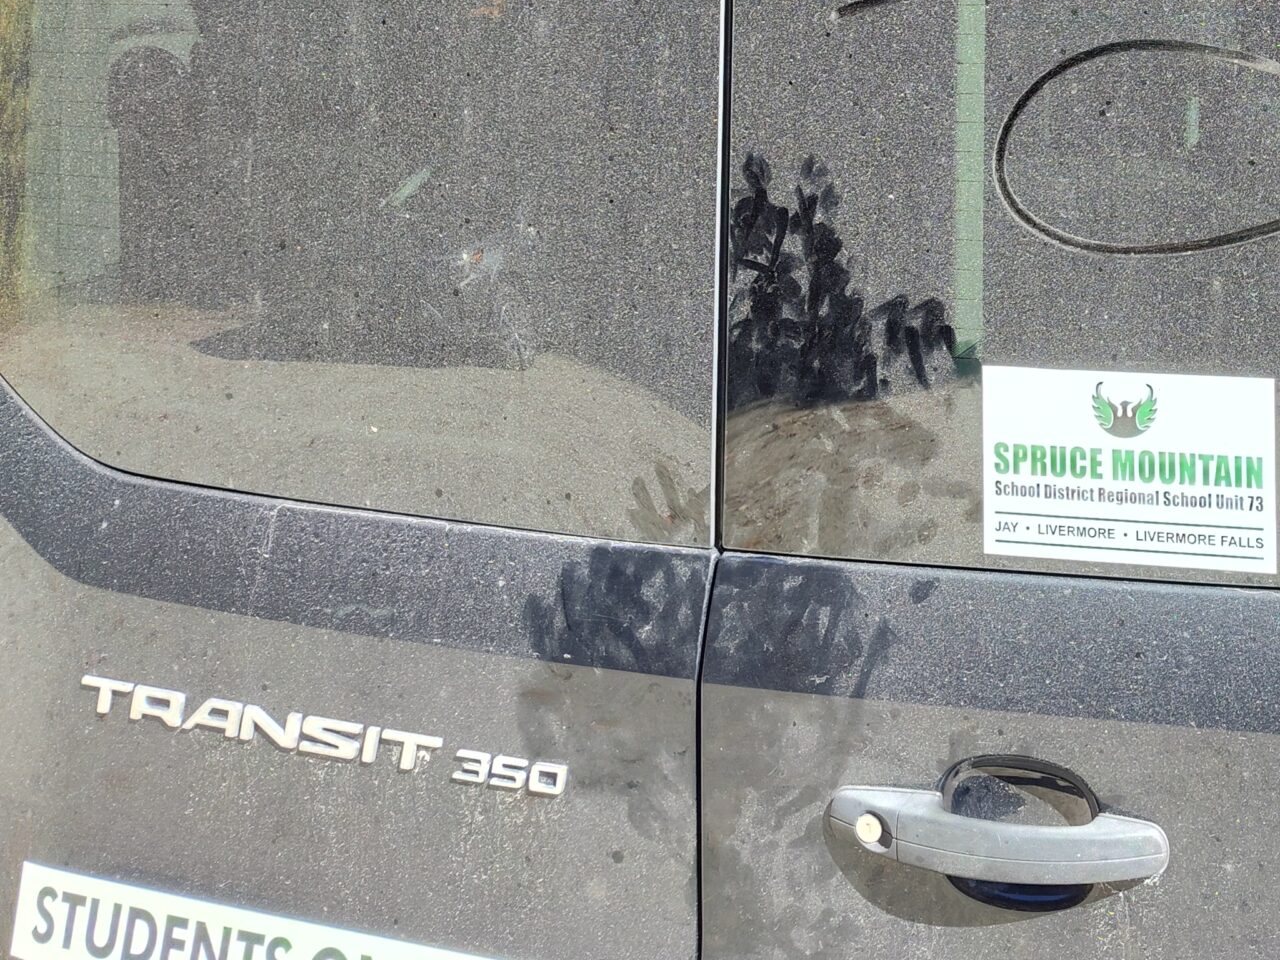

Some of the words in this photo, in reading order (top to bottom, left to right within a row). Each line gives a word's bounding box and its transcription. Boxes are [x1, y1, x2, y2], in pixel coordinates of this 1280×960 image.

[994, 442, 1103, 479] SPRUCE
[1112, 449, 1263, 489] MOUNTAIN
[995, 480, 1040, 498] School
[1044, 484, 1094, 502] District
[1098, 487, 1159, 506] Regional
[1163, 491, 1212, 509] School
[1215, 494, 1245, 511] Unit
[1247, 496, 1264, 512] 73
[995, 521, 1018, 532] JAY
[1038, 524, 1116, 540] LIVERMORE
[1136, 530, 1216, 546] LIVERMORE
[1221, 535, 1264, 549] FALLS
[81, 674, 443, 771] TRANSIT
[451, 749, 568, 795] 350
